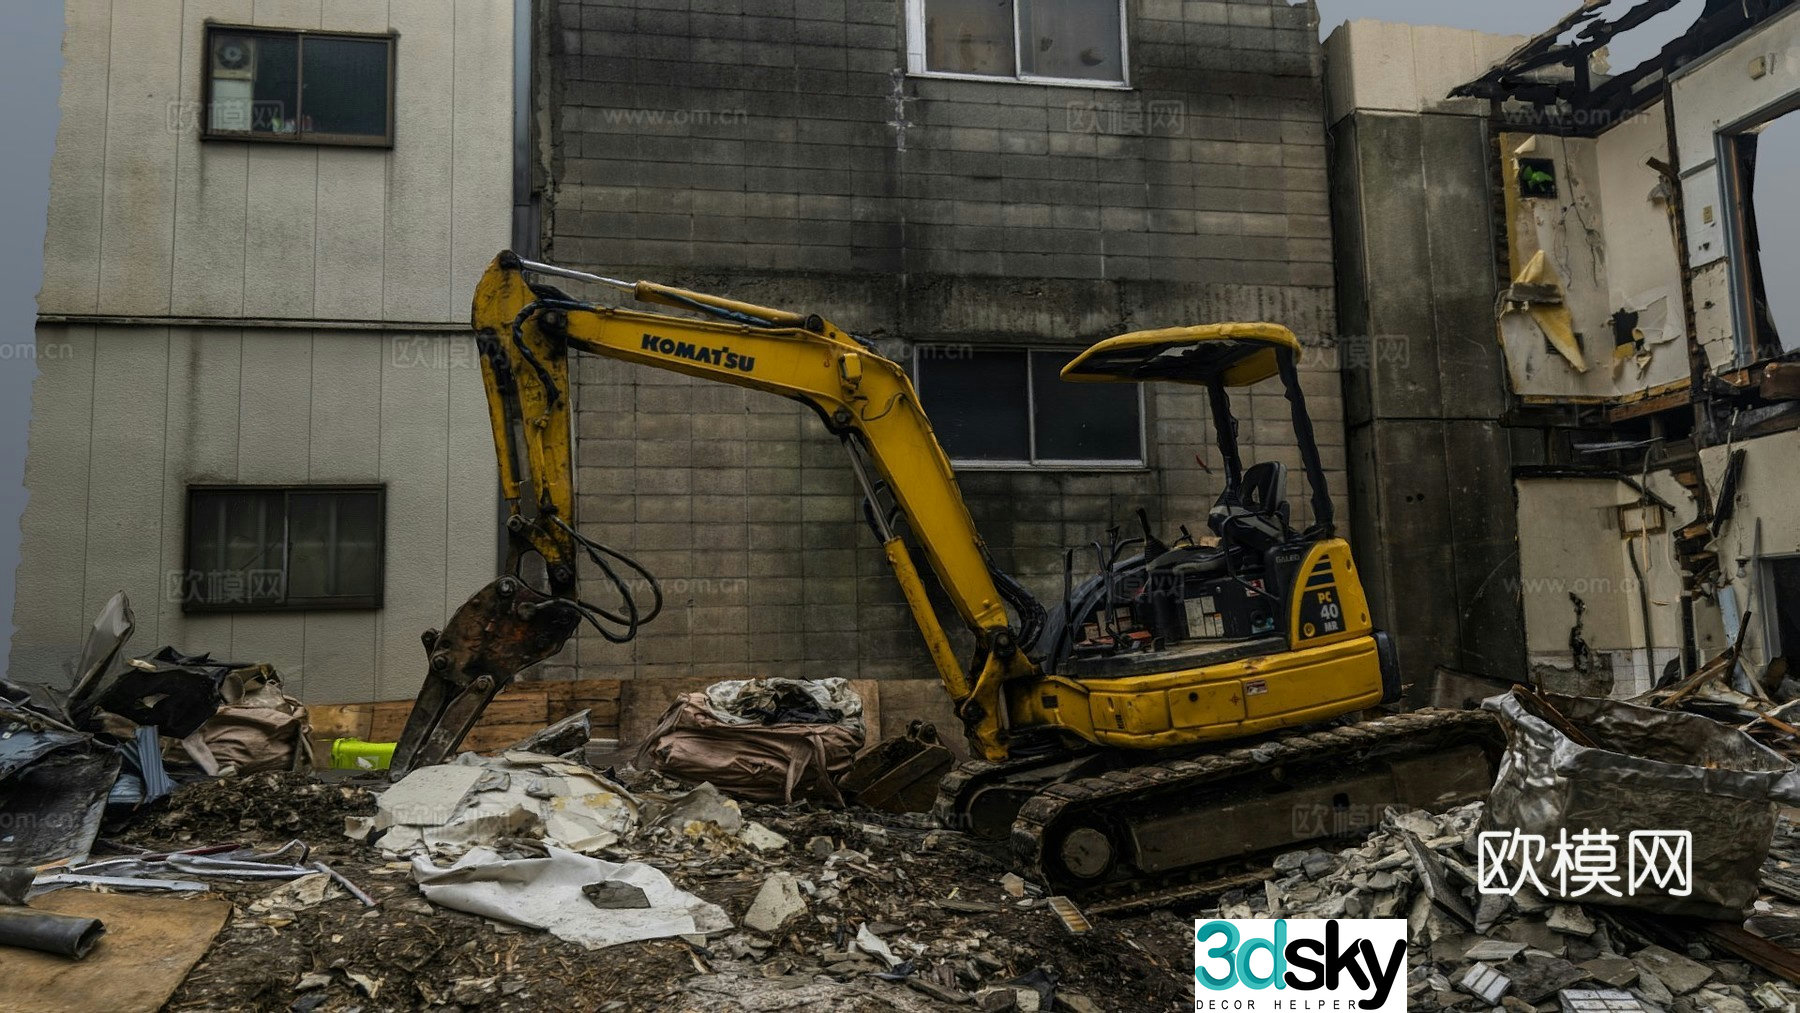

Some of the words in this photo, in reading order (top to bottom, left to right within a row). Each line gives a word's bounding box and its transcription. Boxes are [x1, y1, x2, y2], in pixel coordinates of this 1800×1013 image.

[642, 333, 755, 371] KOMATSU
[1317, 591, 1332, 604] PC
[1320, 603, 1339, 620] 40
[1324, 621, 1339, 633] MR
